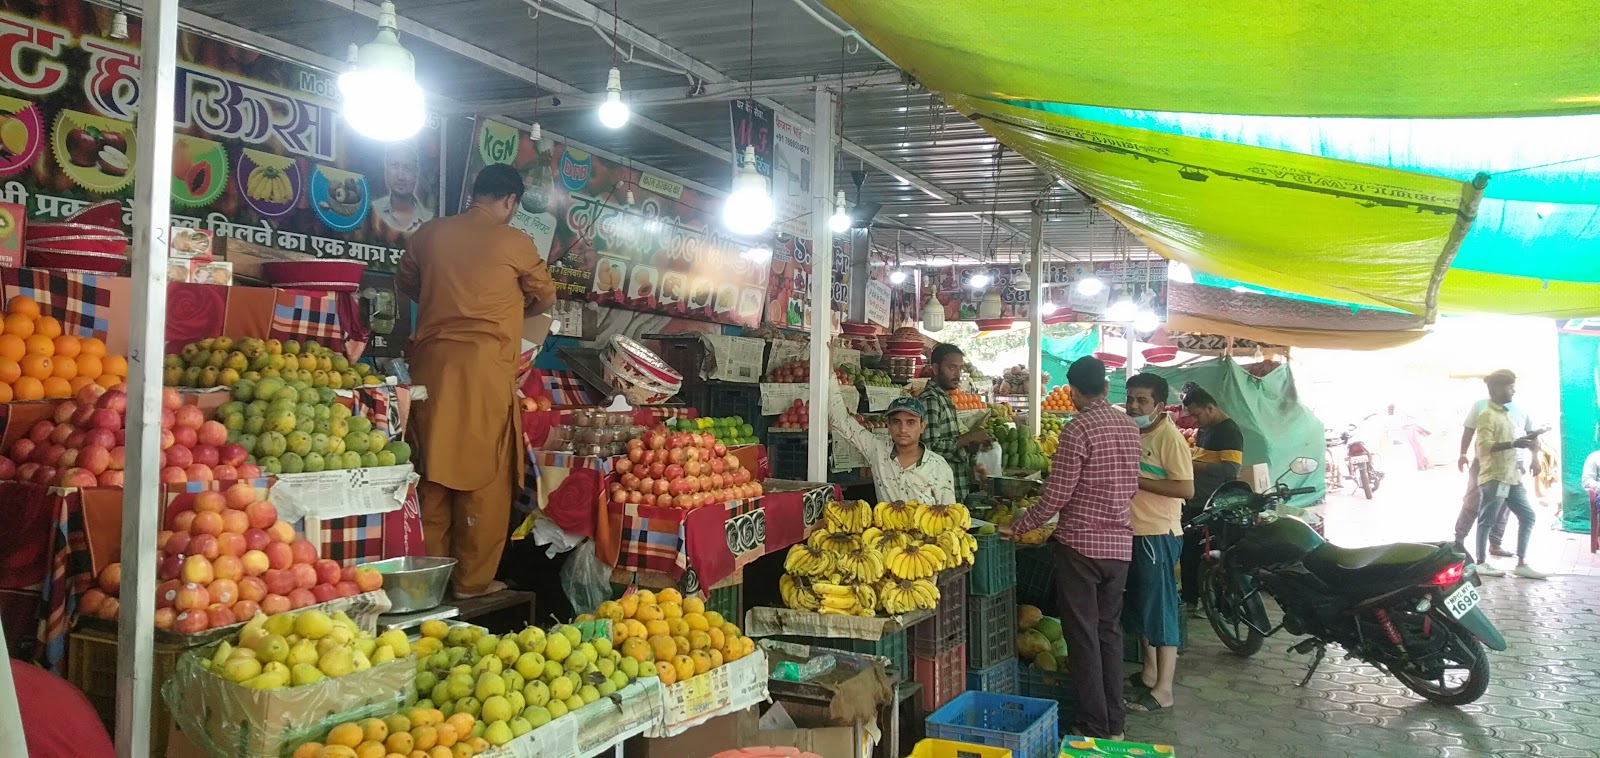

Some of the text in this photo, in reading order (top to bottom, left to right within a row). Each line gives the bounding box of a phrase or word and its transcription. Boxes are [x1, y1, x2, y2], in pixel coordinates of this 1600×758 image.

[484, 127, 516, 161] KGN
[563, 157, 589, 181] DFB
[206, 212, 273, 246] मिलने
[278, 230, 306, 252] का
[311, 236, 345, 258] एक
[348, 241, 386, 263] मात्र
[1452, 590, 1479, 615] 1696
